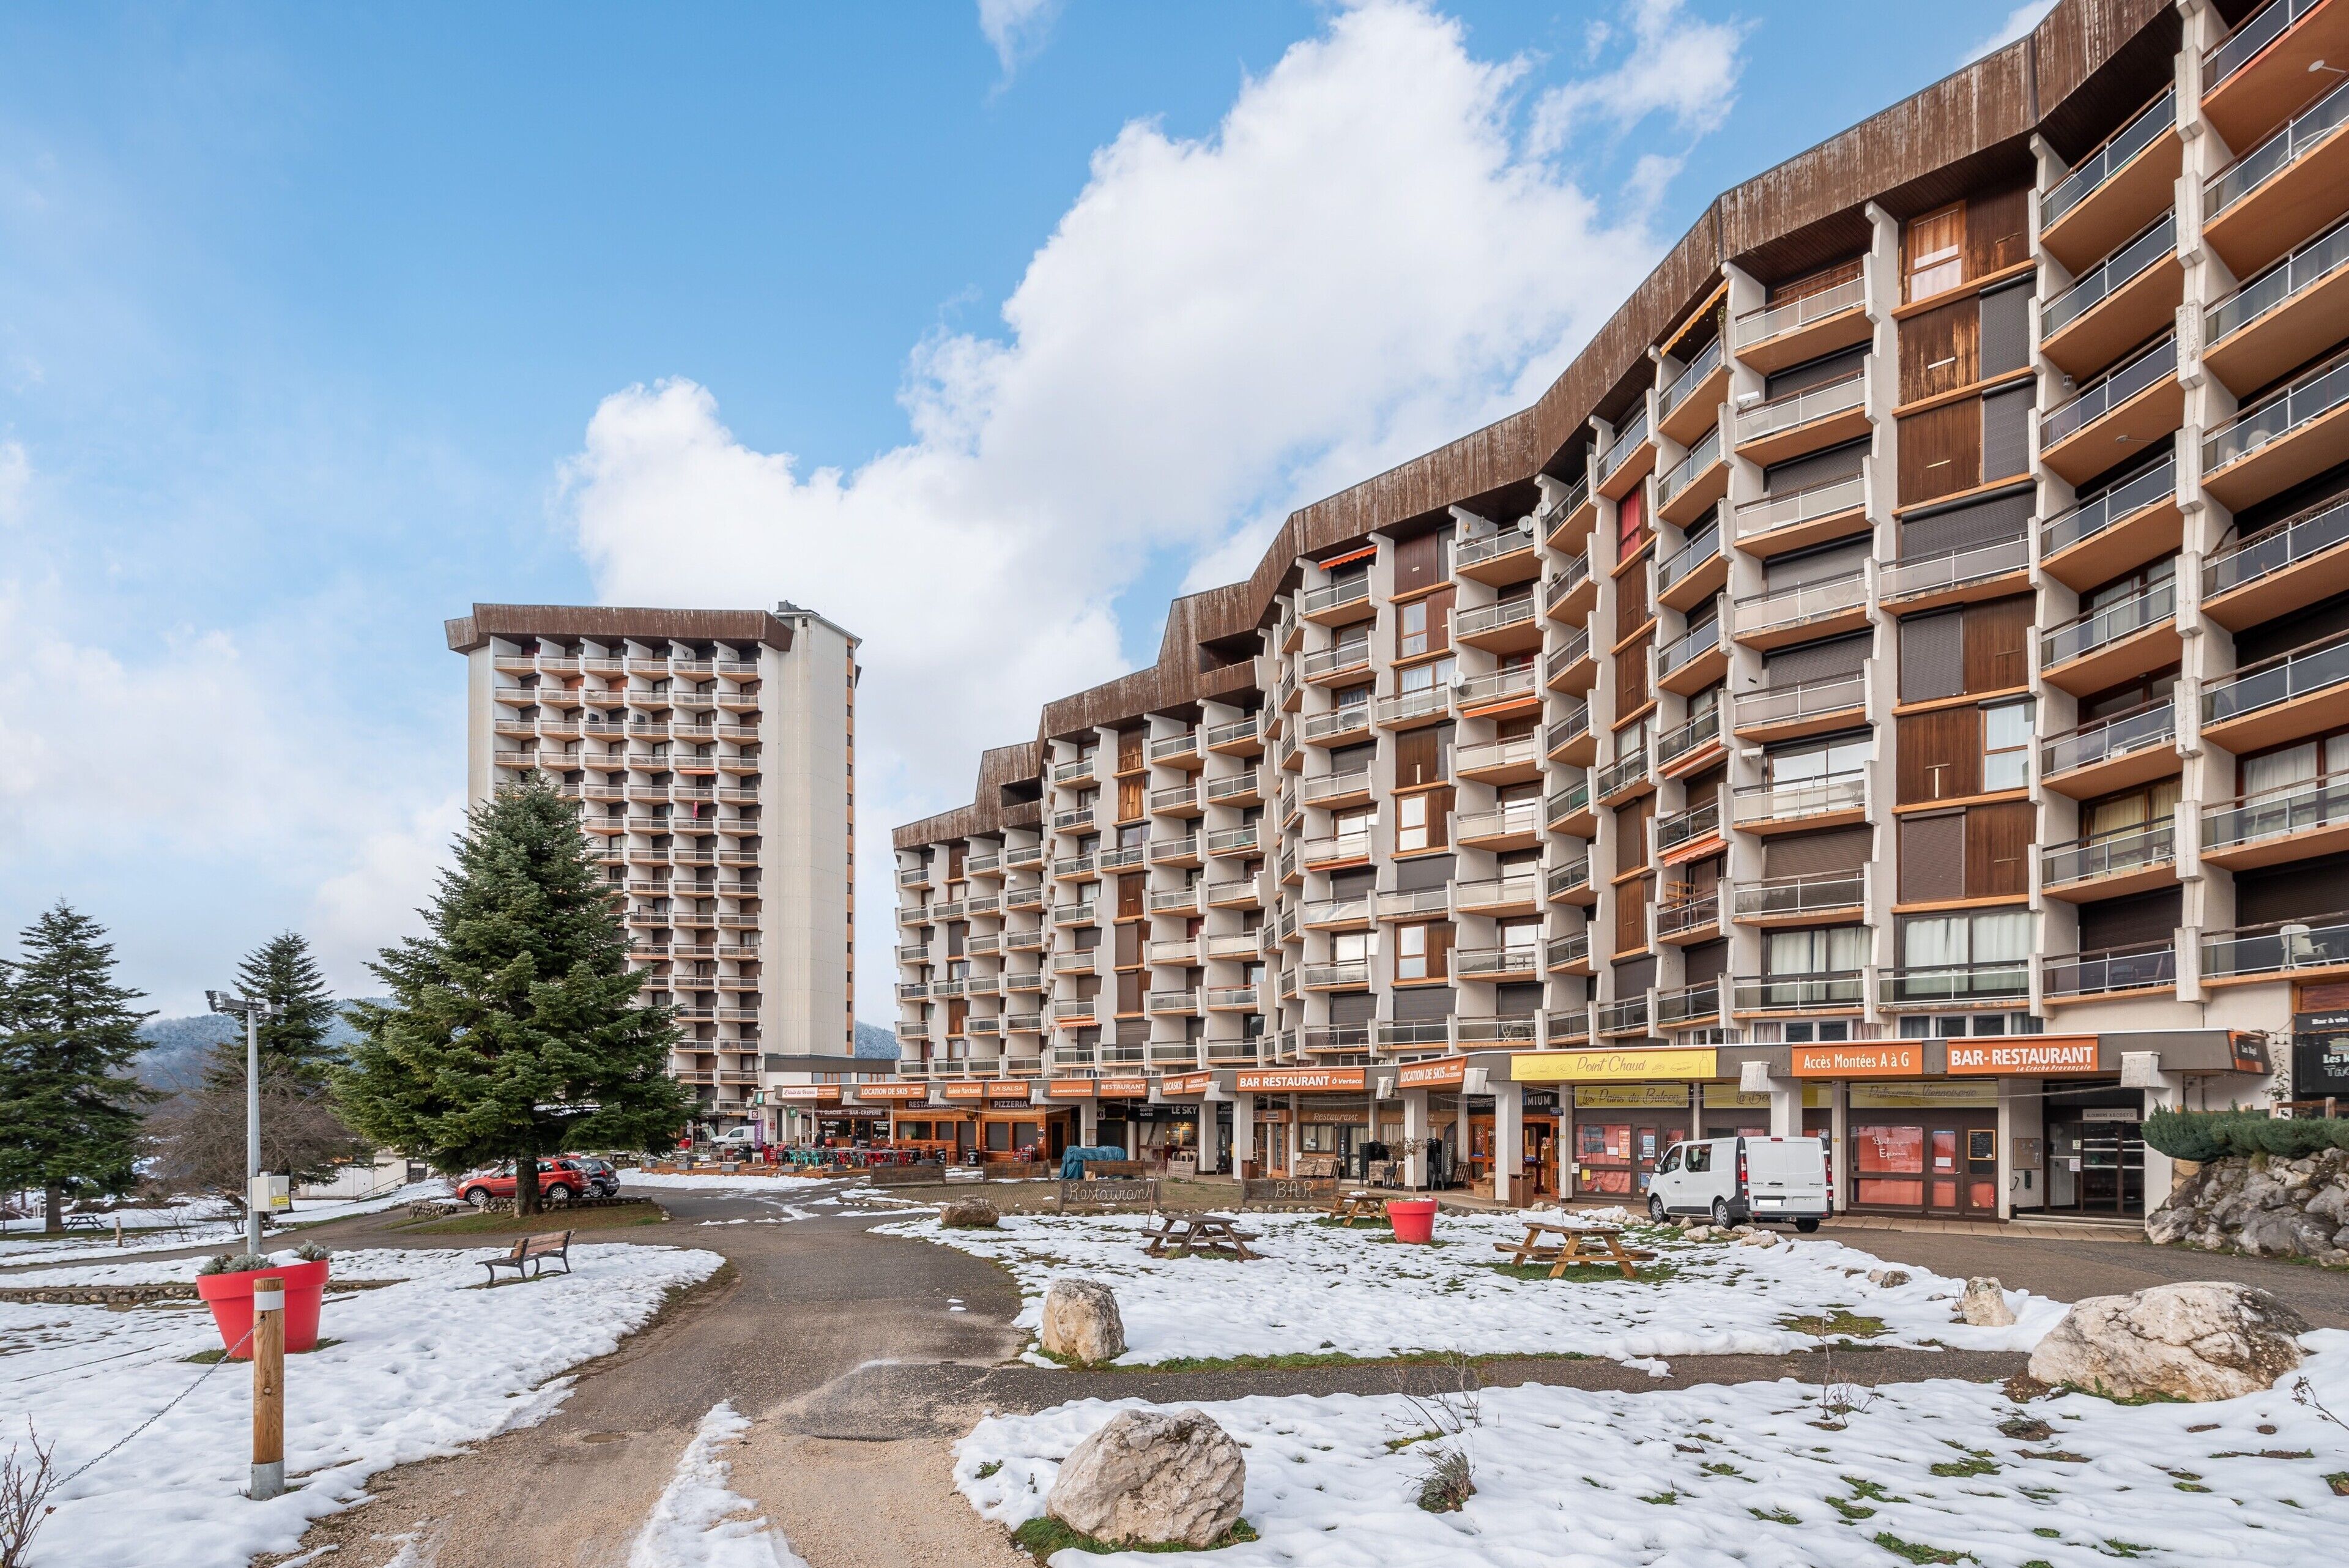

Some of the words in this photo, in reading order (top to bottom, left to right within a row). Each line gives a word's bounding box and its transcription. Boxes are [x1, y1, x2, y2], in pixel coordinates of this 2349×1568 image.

[1577, 1057, 1608, 1072] Point
[1609, 1055, 1646, 1072] Chaud
[1804, 1054, 1831, 1069] Accès
[1835, 1053, 1876, 1068] Montées
[1880, 1052, 1888, 1068] A
[1891, 1052, 1898, 1067] à
[1901, 1052, 1909, 1067] G
[2323, 1054, 2340, 1063] Les
[1240, 1077, 1260, 1087] BAR
[1263, 1076, 1330, 1087] RESTAURANT
[1401, 1069, 1425, 1082] LOCATION
[1425, 1068, 1432, 1080] DE
[1433, 1066, 1445, 1079] SKIS
[1163, 1080, 1183, 1091] LOCASKIS
[1581, 1090, 1595, 1105] Les
[1599, 1088, 1624, 1106] Pains
[1628, 1092, 1640, 1102] du
[1182, 1105, 1197, 1114] SKY
[1313, 1113, 1359, 1121] Restaurant
[1067, 1183, 1151, 1202] Restaurant
[1274, 1180, 1315, 1198] BAR
